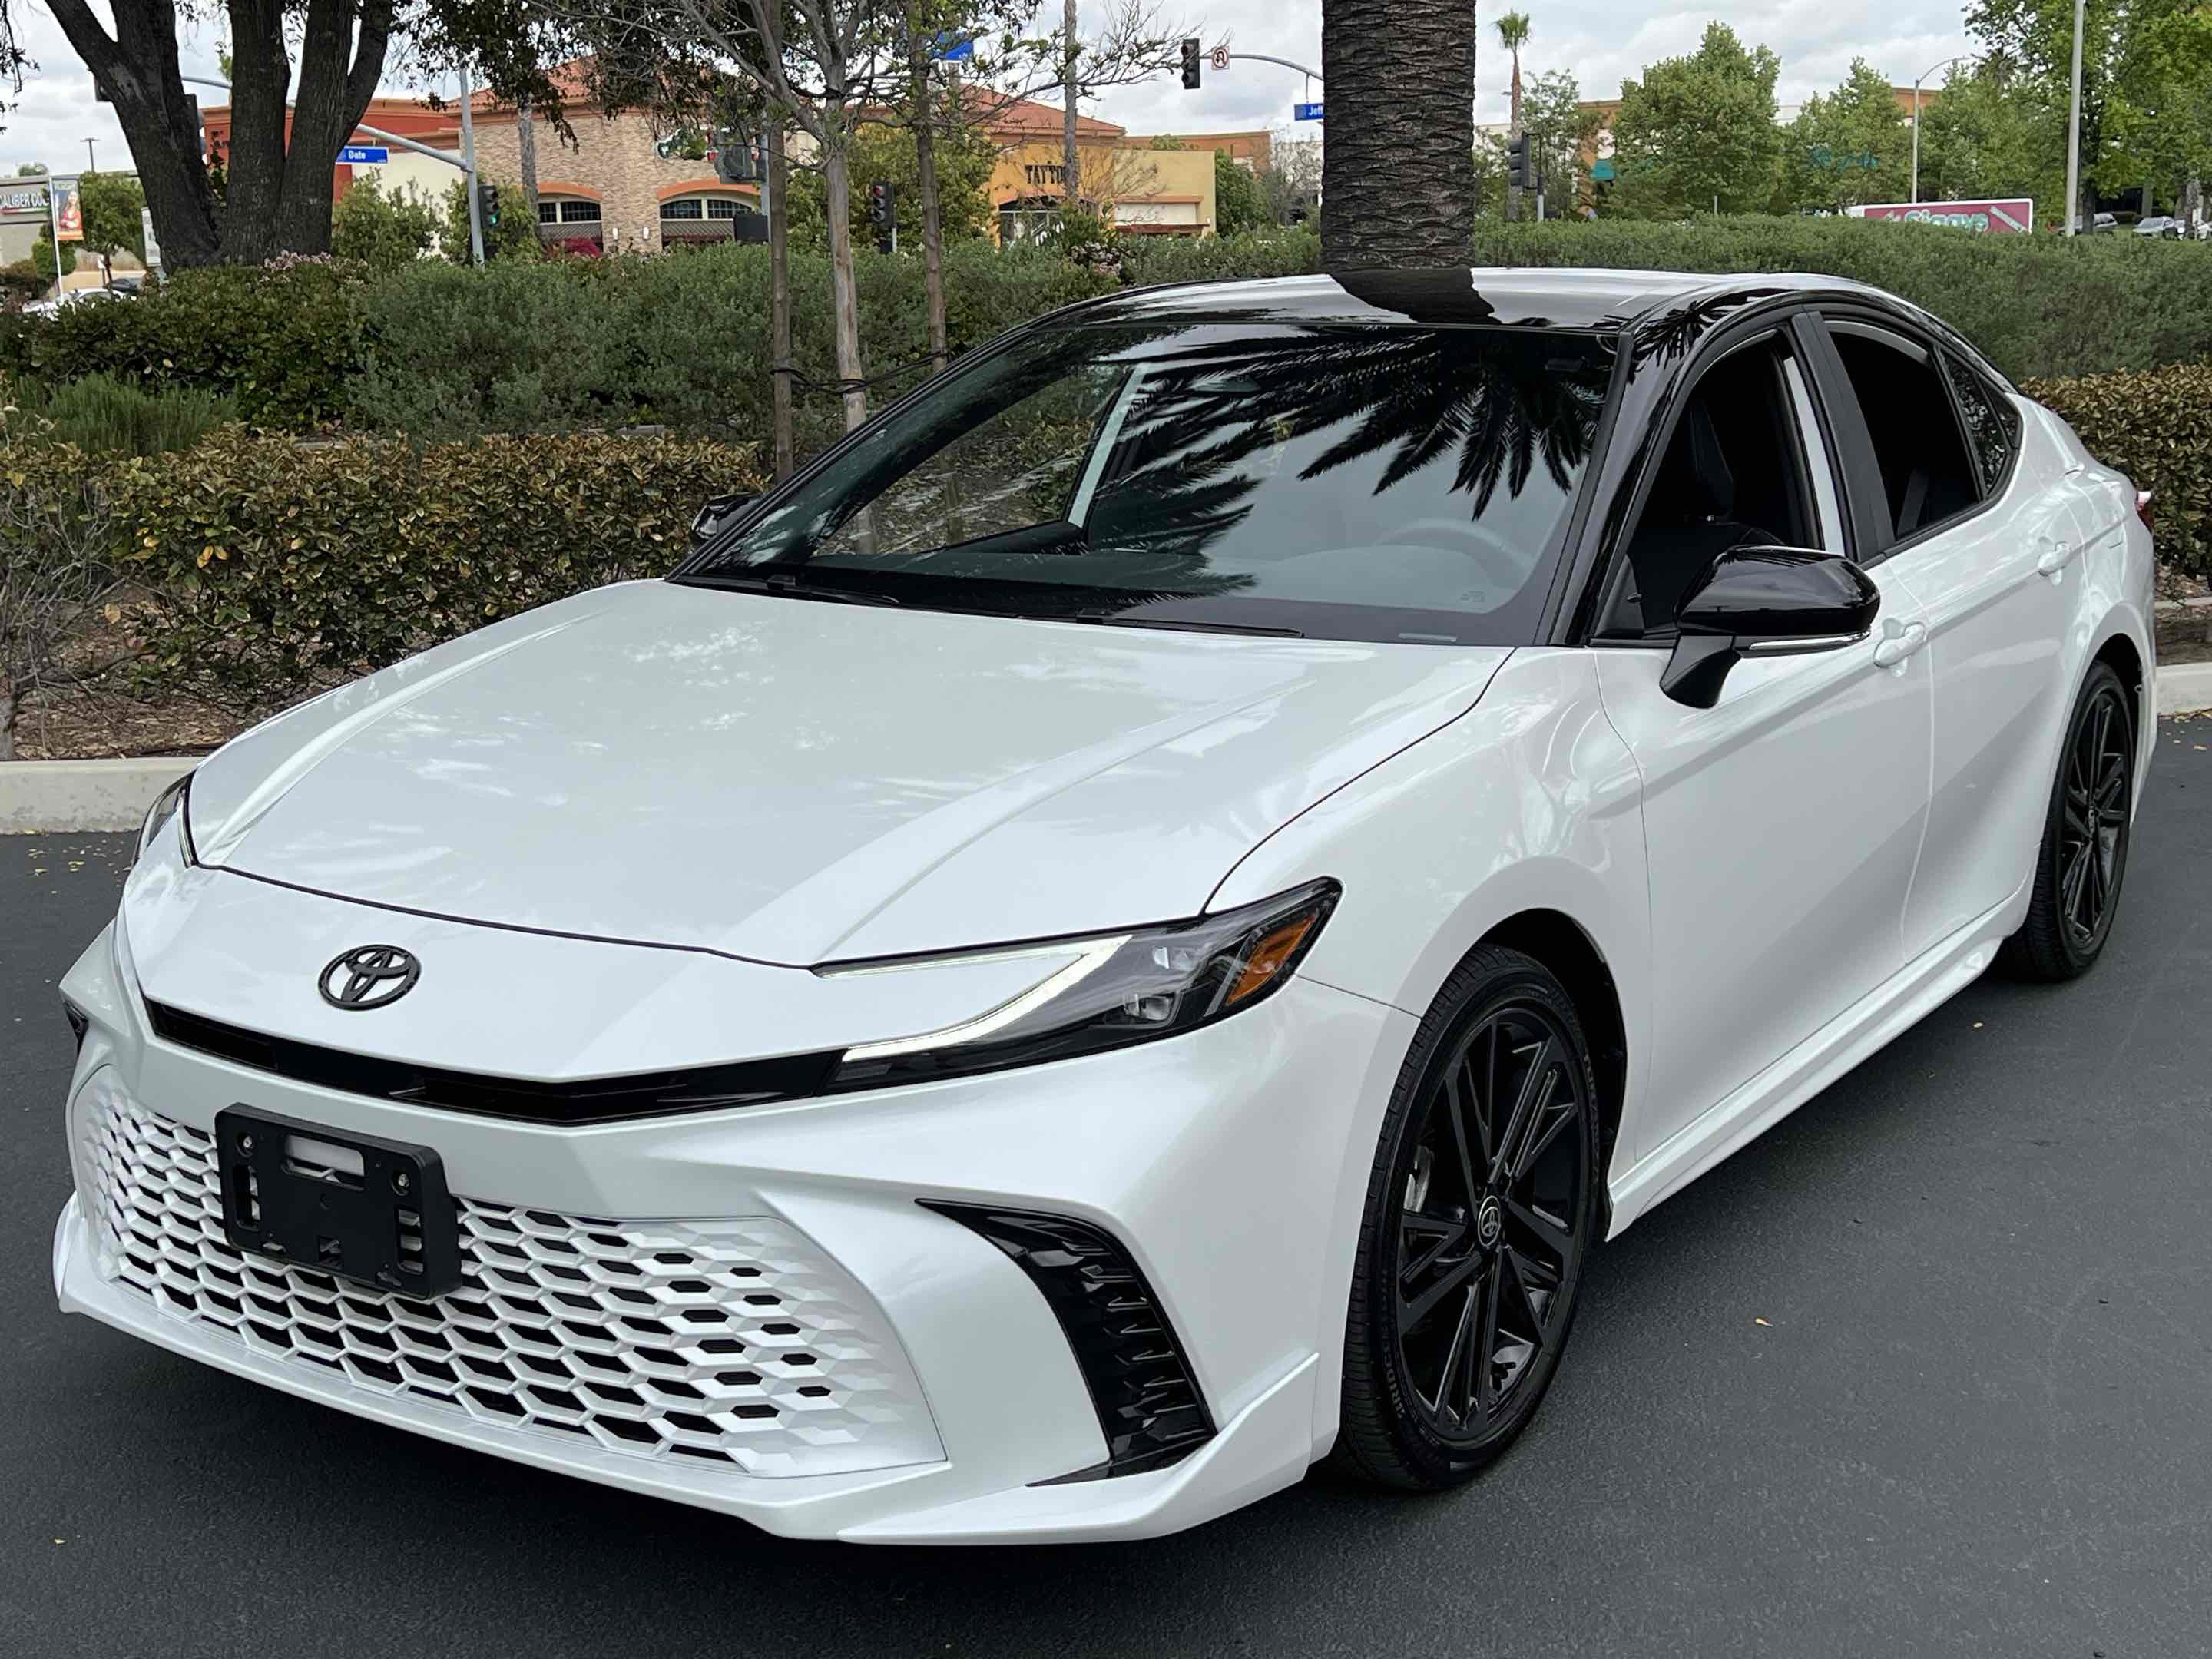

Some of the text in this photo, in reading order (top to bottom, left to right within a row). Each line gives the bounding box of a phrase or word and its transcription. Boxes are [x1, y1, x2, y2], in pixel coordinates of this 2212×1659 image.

[1308, 104, 1323, 116] Jeff
[348, 149, 366, 160] Date
[1025, 164, 1064, 184] TATTO
